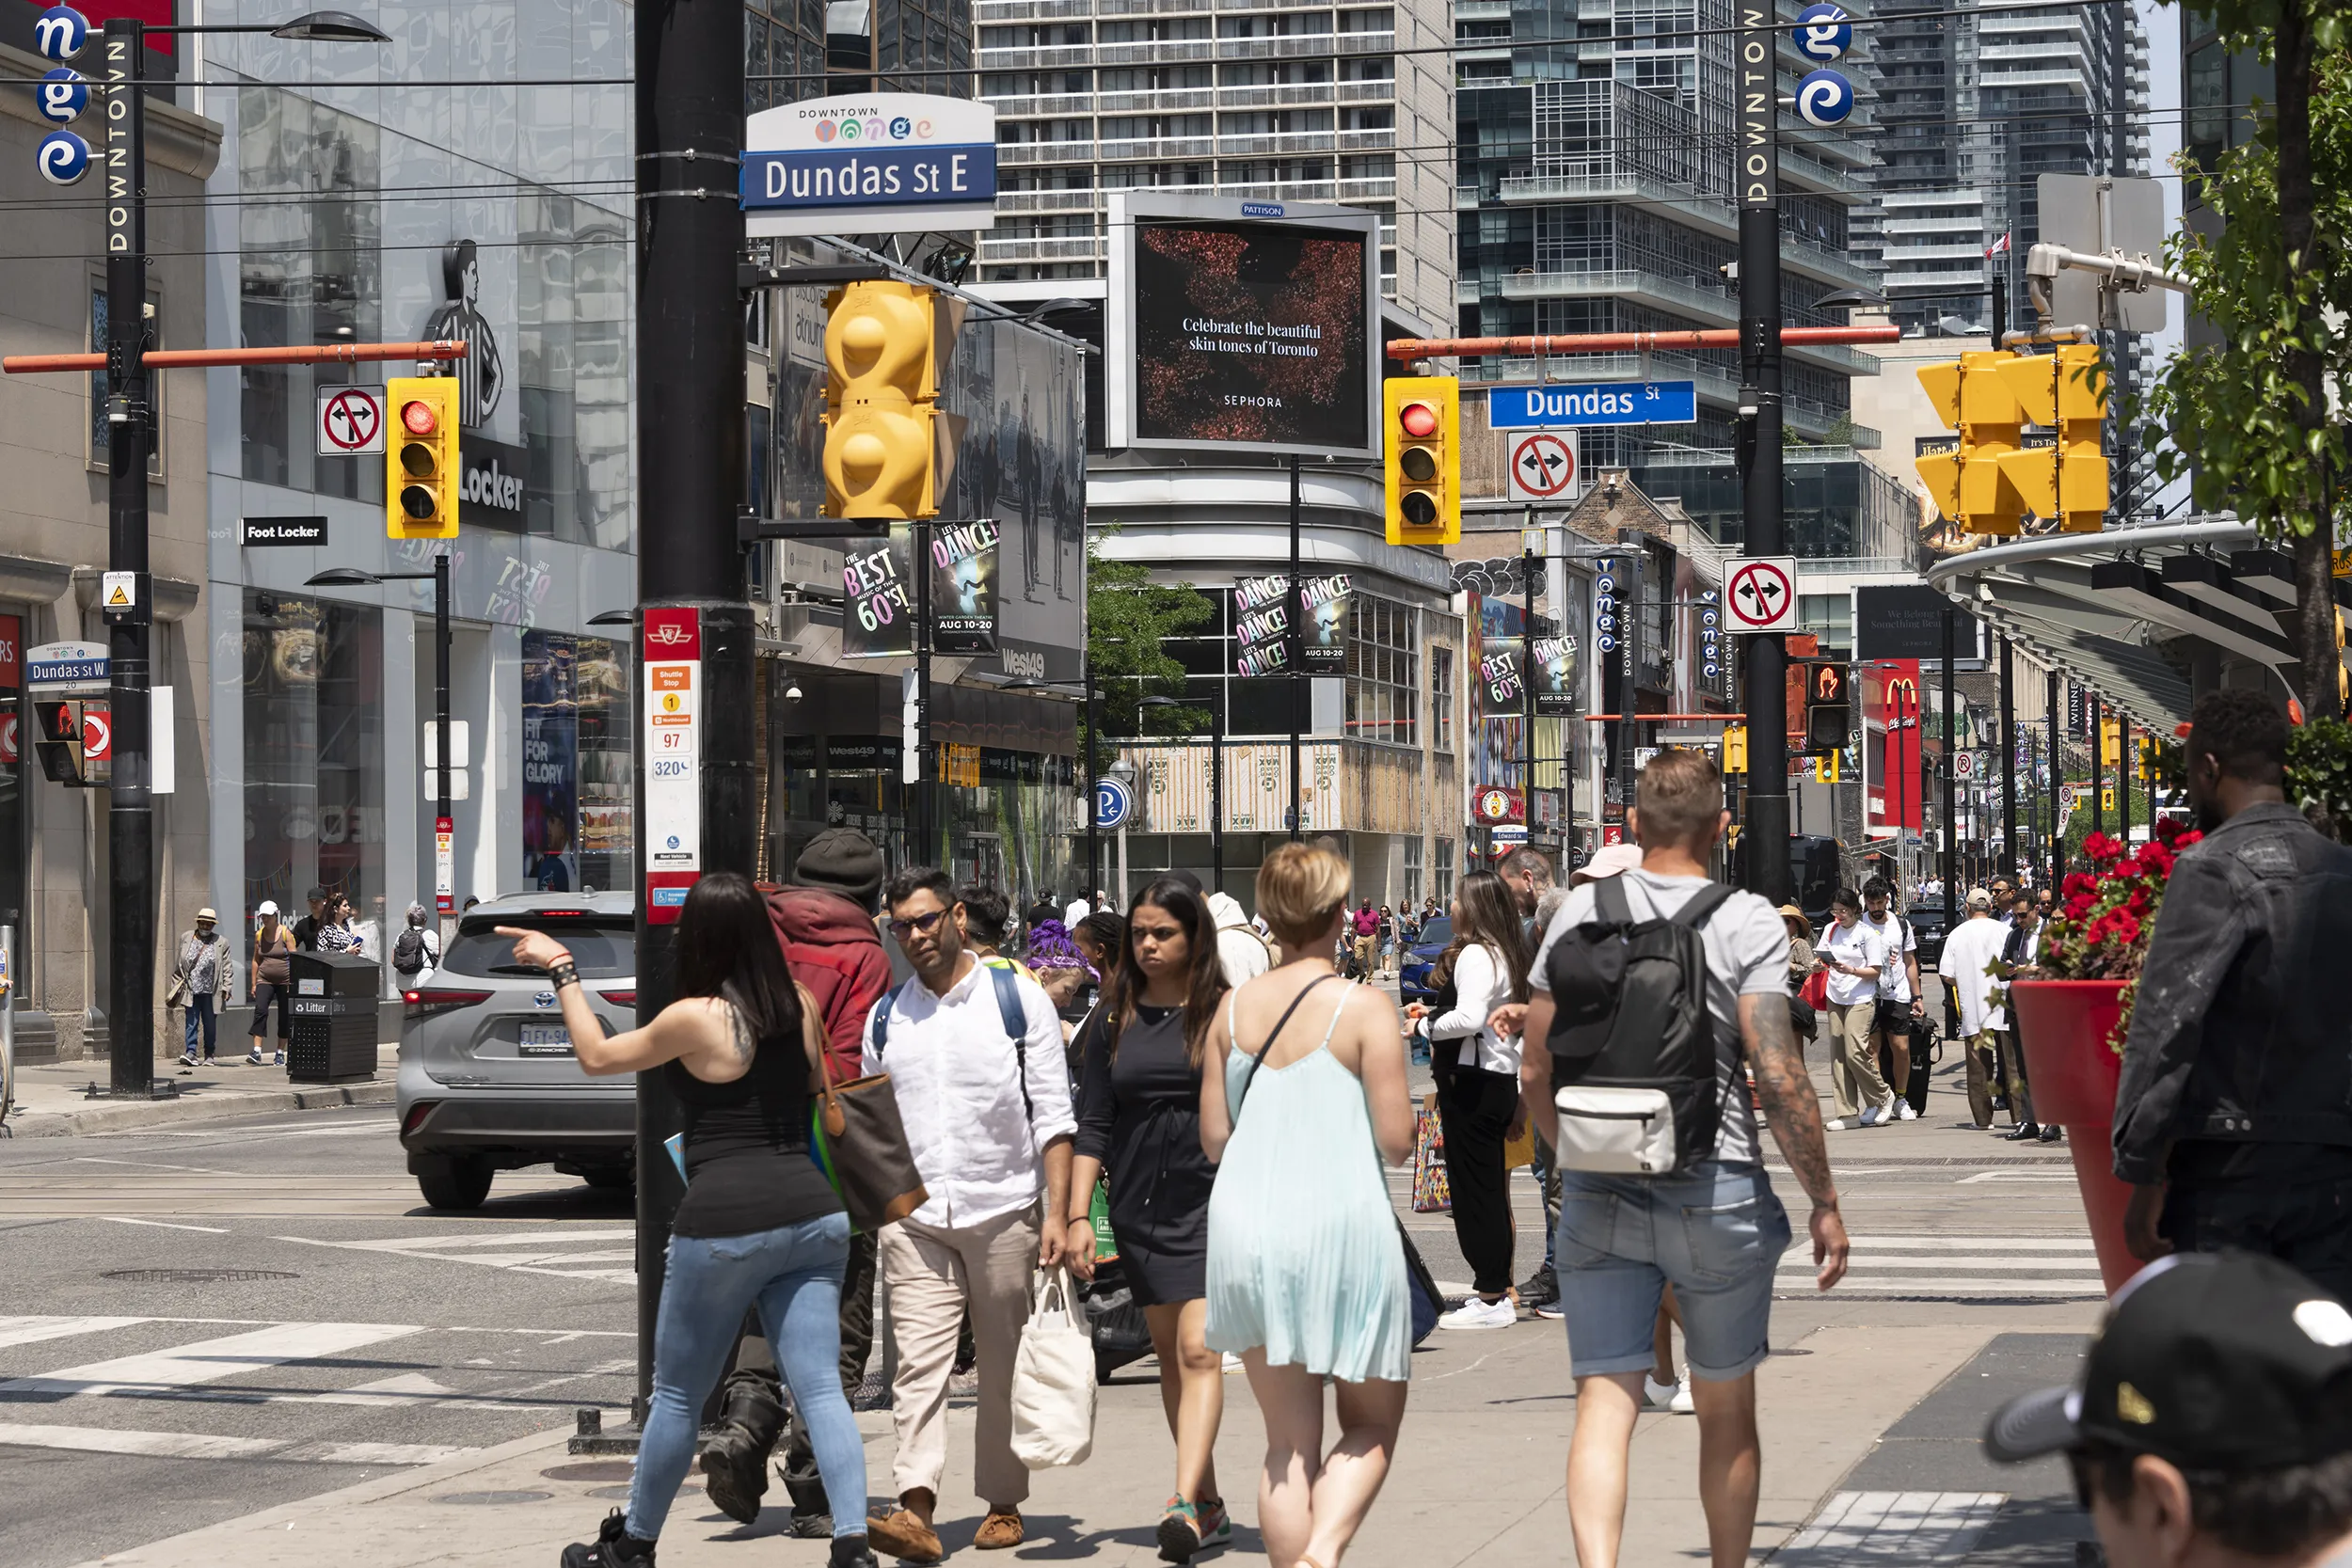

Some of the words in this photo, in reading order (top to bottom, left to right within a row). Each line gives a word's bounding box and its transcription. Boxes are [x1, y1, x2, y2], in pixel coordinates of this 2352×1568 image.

[800, 108, 878, 119] DOWNTOWN
[1743, 8, 1768, 202] DOWNTOW
[108, 41, 128, 252] DOWNTOWN
[766, 158, 900, 198] Dundas
[914, 163, 940, 193] St
[952, 154, 967, 191] E
[1244, 205, 1281, 215] PATTISON
[796, 309, 826, 349] atrium
[1183, 317, 1242, 335] Celebrate
[1245, 321, 1263, 336] the
[1267, 322, 1321, 340] beautiful
[1189, 337, 1216, 352] skin
[1218, 340, 1252, 354] tones
[1255, 340, 1267, 354] of
[1269, 341, 1318, 356] Toronto
[1224, 395, 1282, 407] SEPHORA
[1527, 388, 1634, 417] Dundas
[1645, 385, 1661, 401] St
[459, 451, 523, 511] Locker
[248, 527, 275, 538] Foot
[278, 525, 320, 538] Locker
[941, 522, 959, 535] LET'S
[932, 519, 1000, 569] DANCE!
[846, 552, 859, 565] THE
[973, 548, 994, 561] MUSICAL
[844, 547, 897, 597] BEST
[1241, 577, 1255, 586] LET'S
[857, 590, 875, 601] MUSIC
[875, 584, 883, 594] OF
[883, 579, 895, 589] THE
[1300, 574, 1352, 610] DANCE!
[857, 583, 911, 632] 60'S!
[1242, 610, 1256, 621] LET'S
[1887, 610, 1900, 618] We
[1904, 610, 1934, 620] Belong
[939, 621, 961, 629] AUG
[964, 621, 993, 629] 10-20
[1236, 606, 1288, 645] DANCE!
[1871, 620, 1919, 629] Something
[1237, 641, 1288, 677] DANCE!
[1243, 645, 1258, 656] LET'S
[1534, 636, 1578, 665] DANCE!
[34, 664, 79, 679] Dundas
[83, 666, 92, 676] St
[94, 662, 104, 675] W
[1003, 648, 1045, 679] West49
[1482, 652, 1515, 681] BEST
[663, 679, 679, 688] Stop
[1490, 673, 1523, 703] 60'S!
[669, 698, 674, 707] 1
[525, 719, 542, 738] FIT
[664, 734, 680, 748] 97
[829, 746, 876, 755] West49
[526, 740, 548, 762] FOR
[526, 763, 564, 784] GLORY
[655, 761, 680, 776] 320
[1095, 791, 1114, 817] P
[278, 910, 309, 930] Locke
[306, 1003, 326, 1013] Litter
